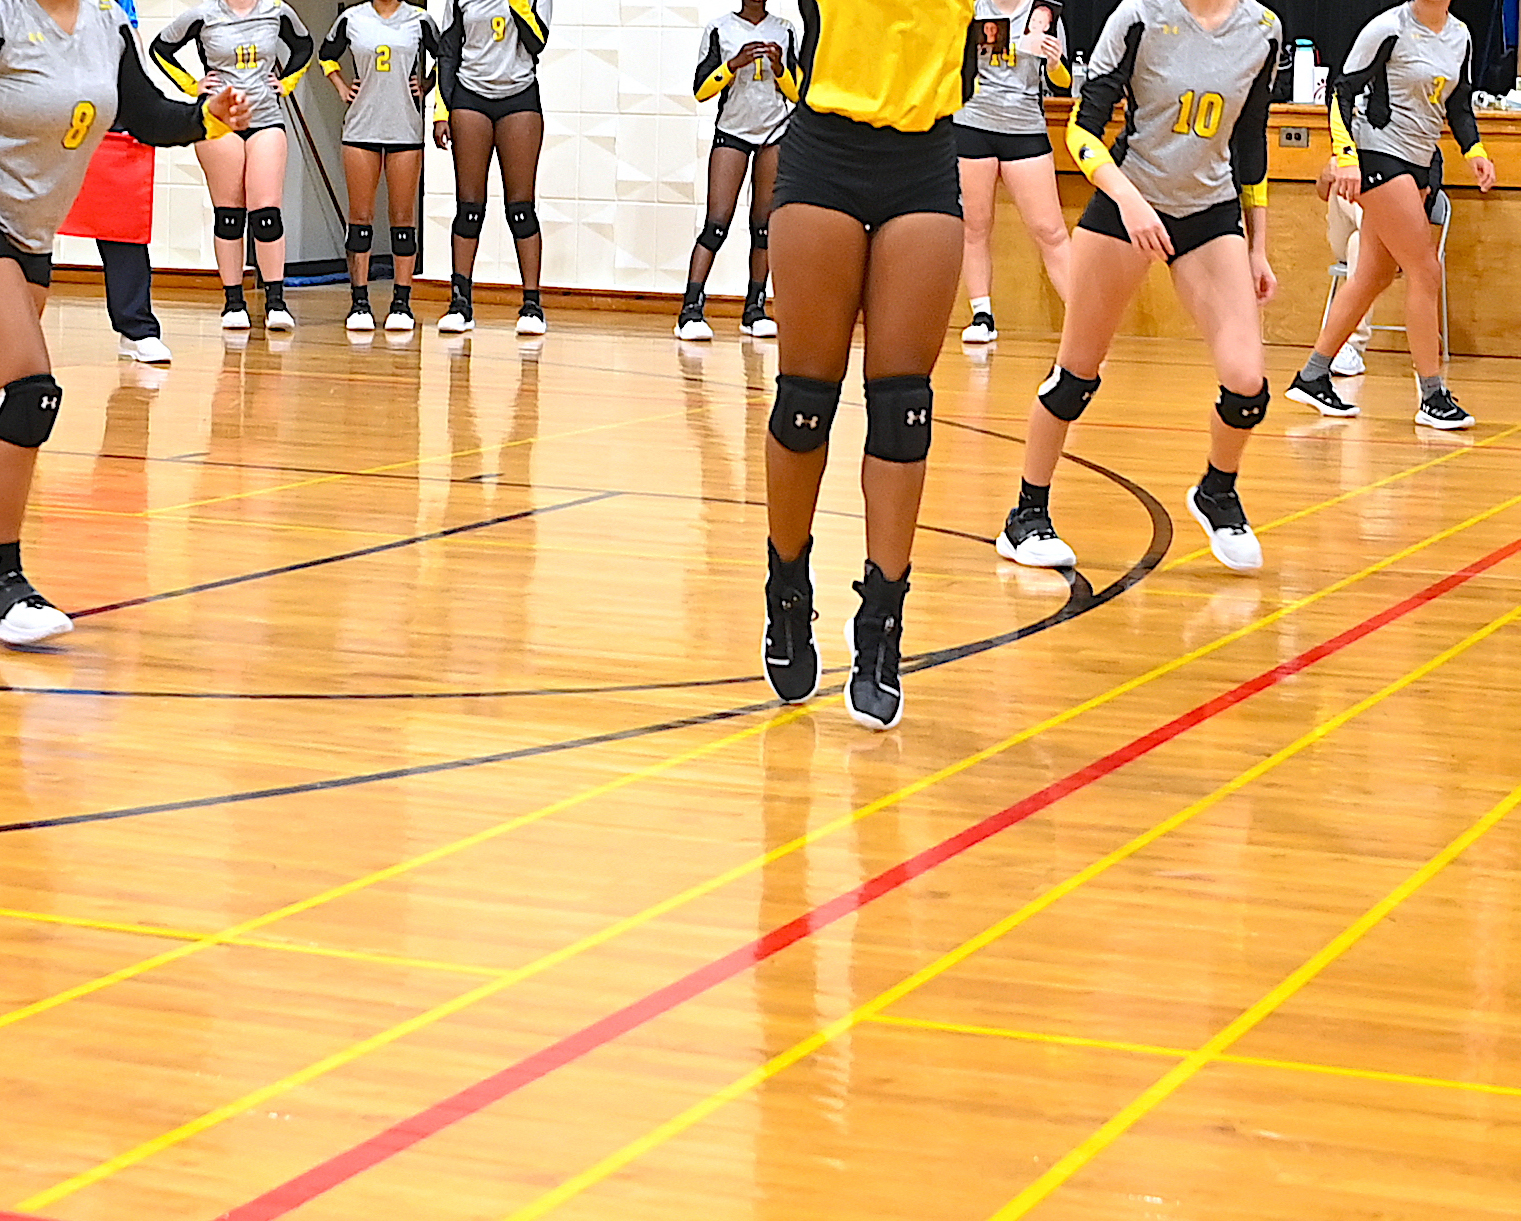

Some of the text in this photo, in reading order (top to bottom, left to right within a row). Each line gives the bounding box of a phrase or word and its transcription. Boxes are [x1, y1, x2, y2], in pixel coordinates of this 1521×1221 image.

[491, 16, 506, 42] 9
[234, 44, 258, 69] 11
[374, 44, 391, 72] 2
[61, 101, 96, 149] 8
[1171, 90, 1225, 138] 10
